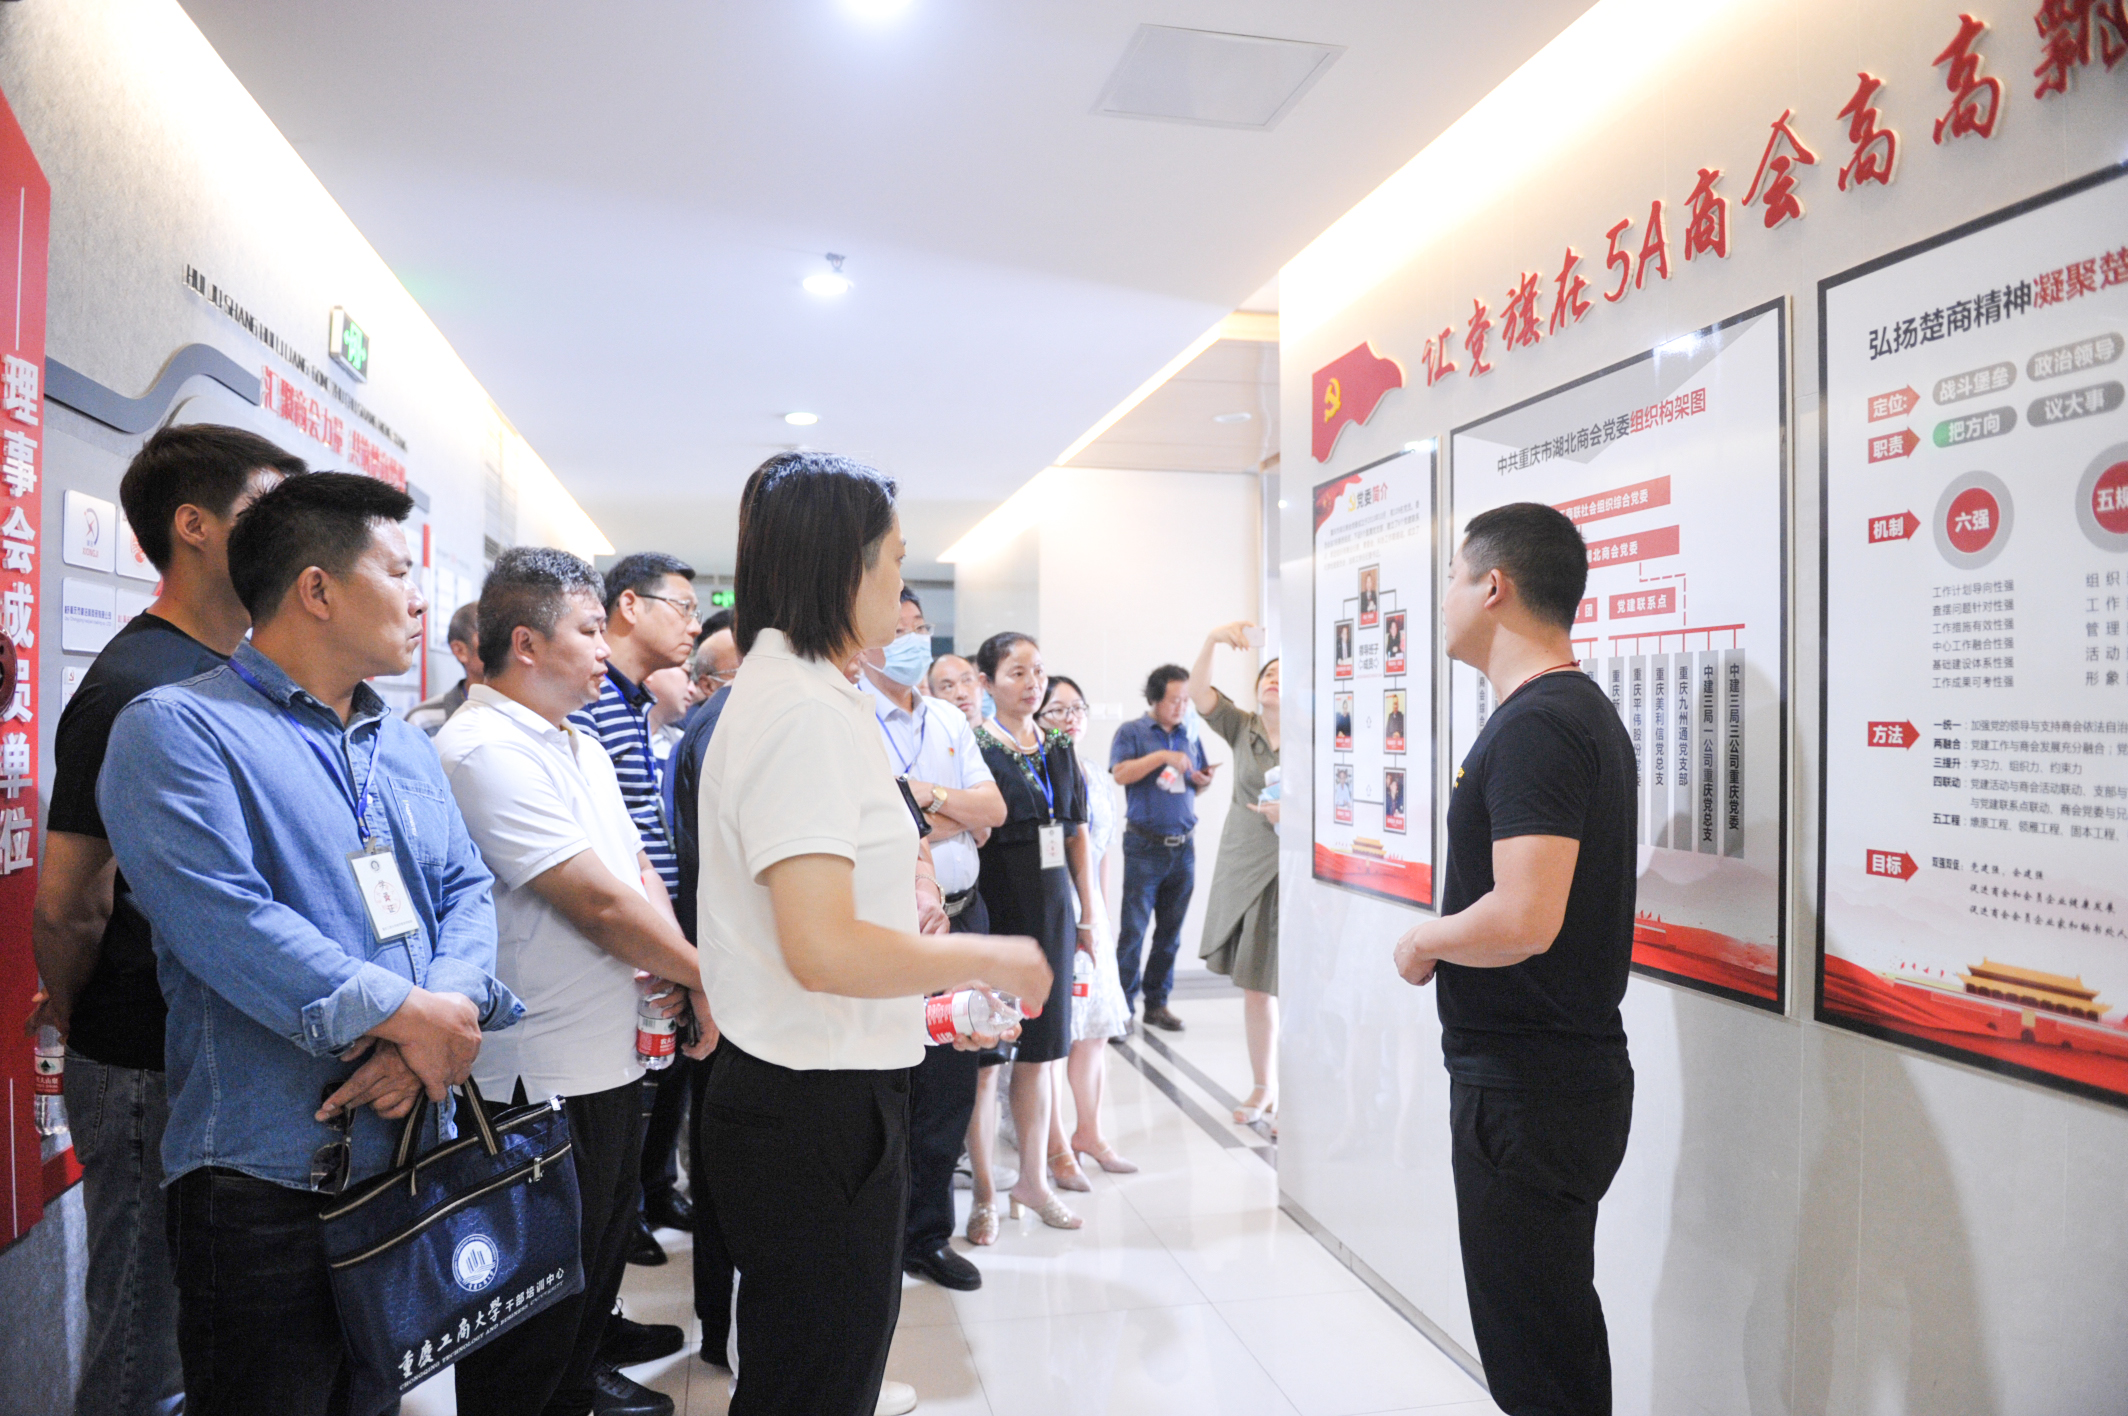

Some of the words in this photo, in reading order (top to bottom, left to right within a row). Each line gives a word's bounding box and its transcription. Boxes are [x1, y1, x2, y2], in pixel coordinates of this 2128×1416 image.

[1869, 246, 2128, 361] 弘扬楚商精神凝聚楚
[2034, 338, 2115, 378] 政治领导
[1939, 368, 2009, 402] 战斗堡垒
[2045, 388, 2105, 420] 议大事
[1497, 387, 1706, 476] 中共重庆市湖北商会党委组织构架图
[1949, 413, 2000, 442] 把方向
[1873, 436, 1903, 458] 职责
[1873, 516, 1903, 539] 机制
[1955, 509, 1990, 533] 六强
[1932, 579, 2015, 598] 工作计划导向性强
[2085, 571, 2128, 588] 组织
[1617, 594, 1667, 614] 党建联系点
[2085, 596, 2128, 613] 工作
[1932, 618, 2015, 634] 工作措施有效性强
[2085, 621, 2128, 637] 管理
[1932, 637, 2015, 653] 中心工作融合性强
[2085, 645, 2128, 662] 活动
[1932, 656, 2015, 671] 基础建设体系性强
[2085, 670, 2128, 687] 形象
[1655, 667, 1664, 786] 重庆美利信党总支
[1679, 666, 1688, 787] 重庆九州通党支部
[1873, 726, 1903, 744] 方法
[1703, 664, 1713, 842] 中建三局一公司重庆党总支
[1729, 663, 1740, 831] 中建三局三公司重庆党委
[1872, 854, 1902, 875] 目标
[442, 1334, 484, 1363] TECHNOLOGY
[485, 1324, 499, 1335] AND
